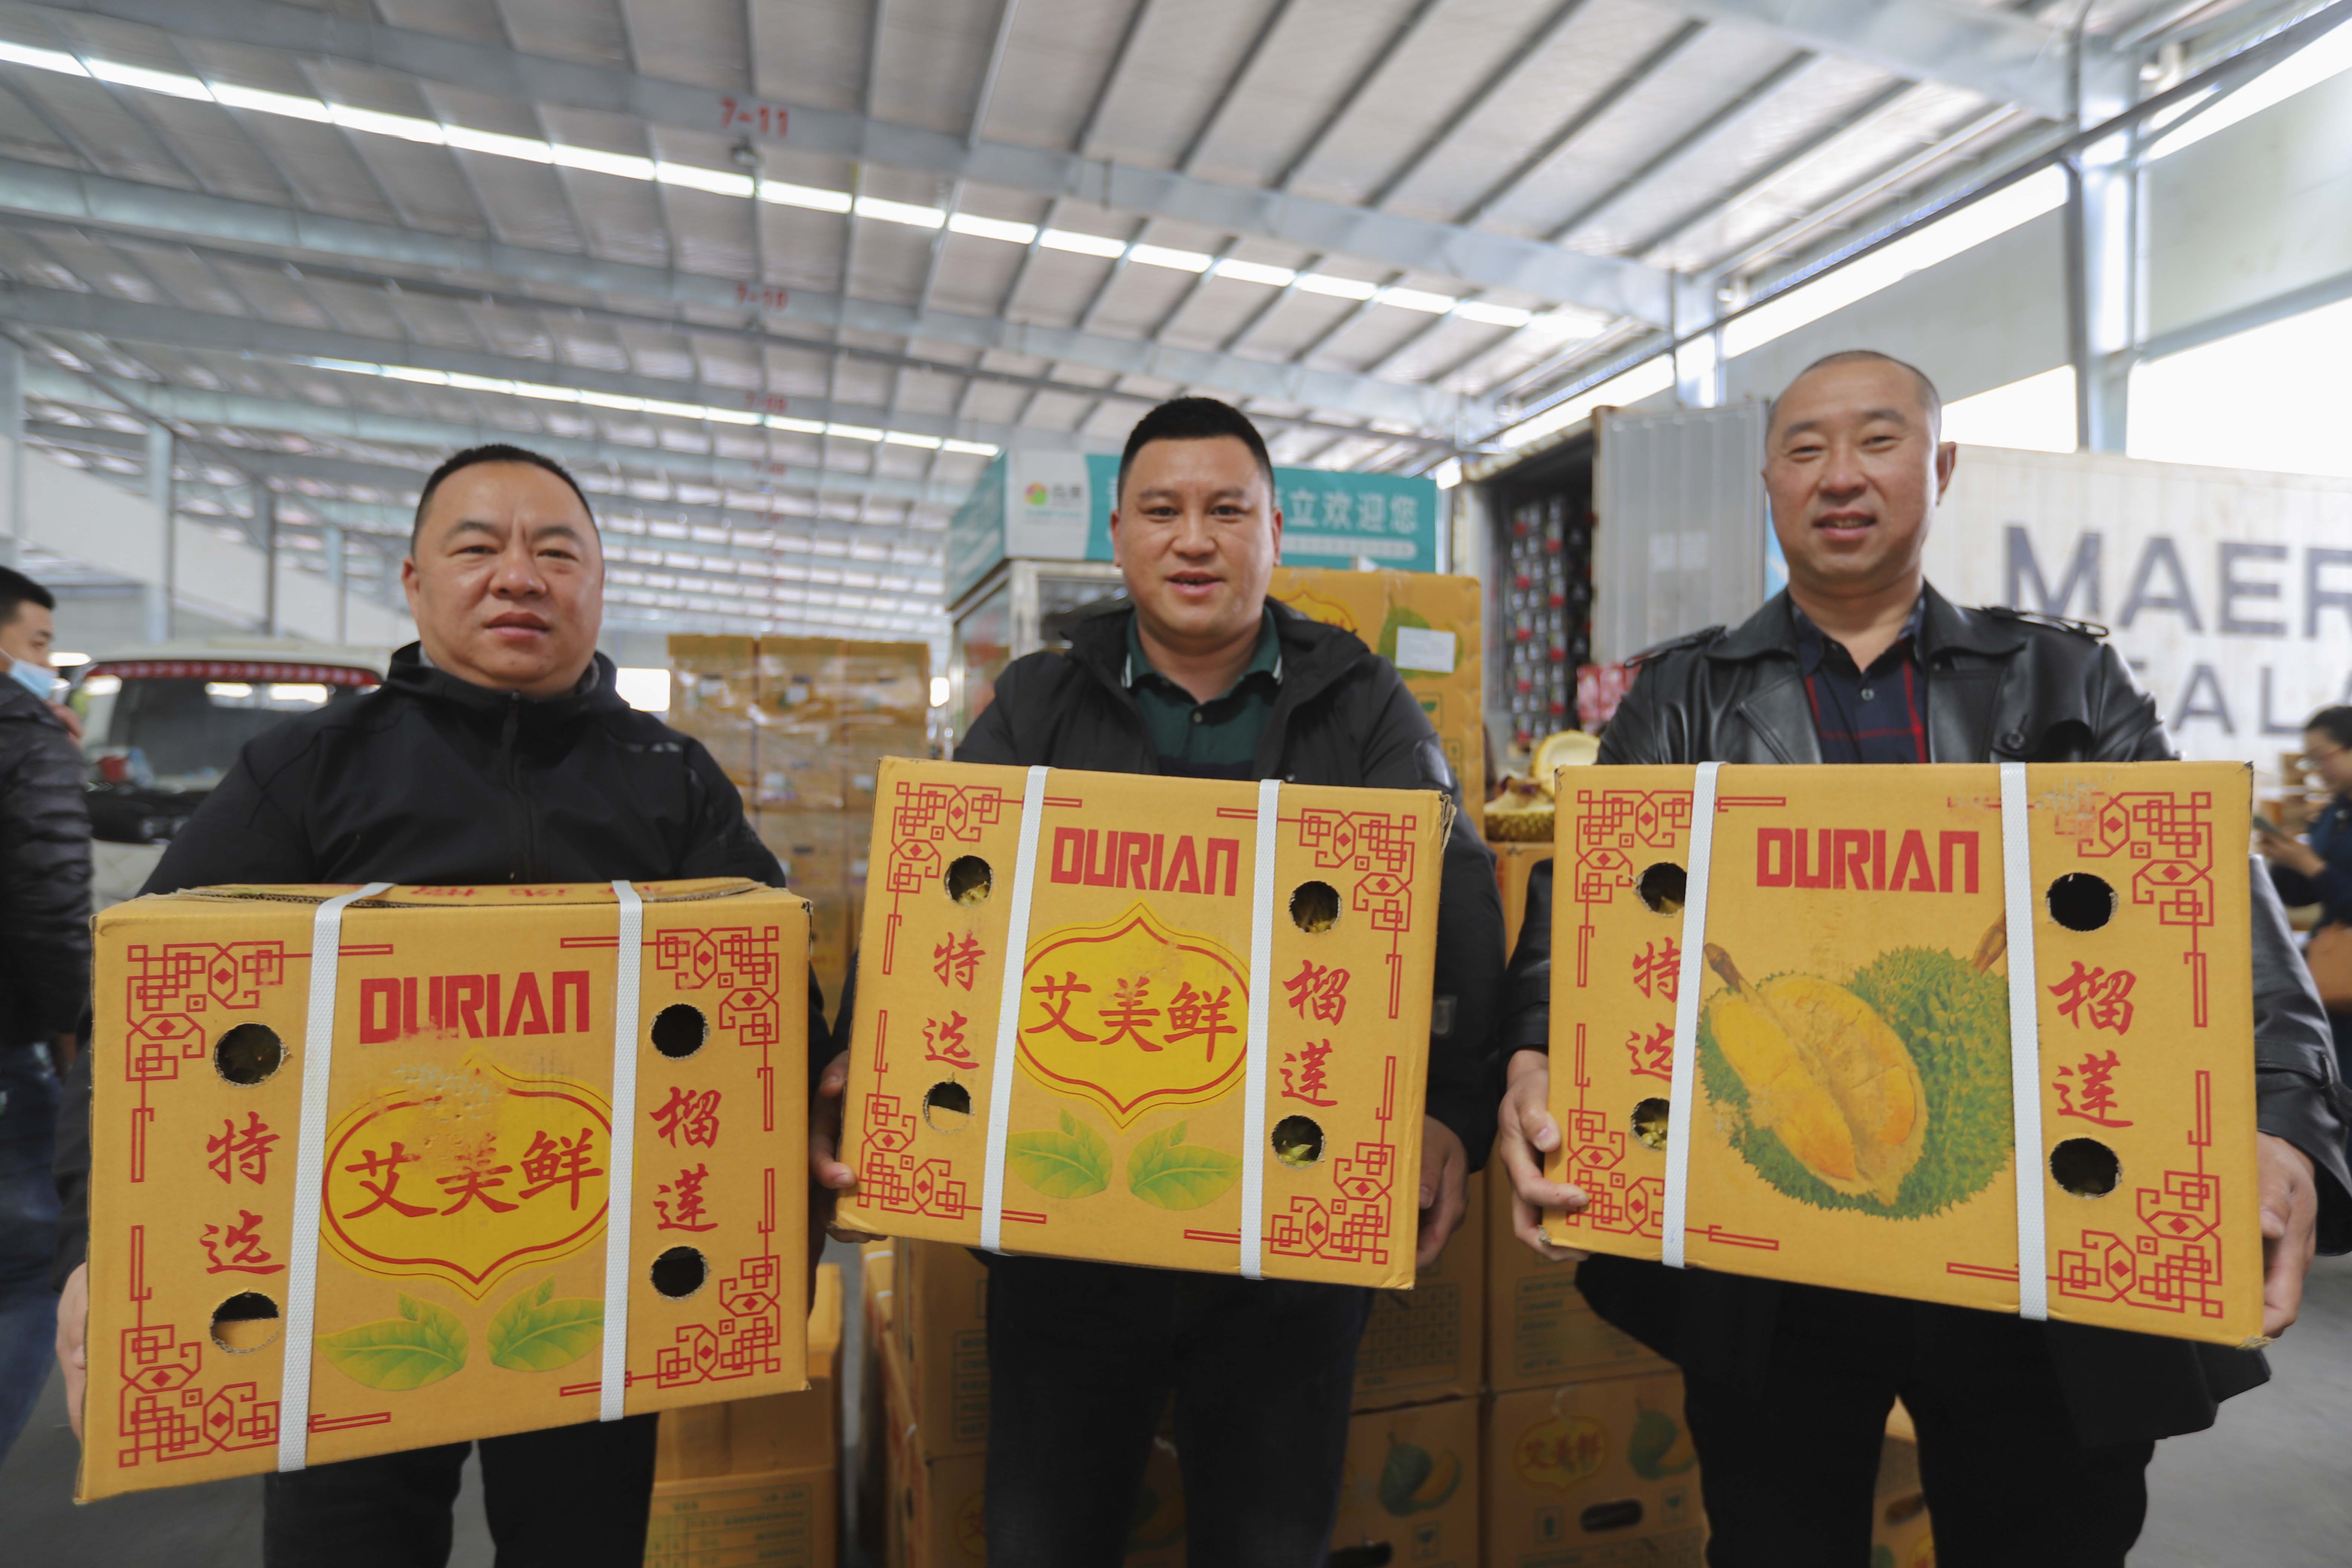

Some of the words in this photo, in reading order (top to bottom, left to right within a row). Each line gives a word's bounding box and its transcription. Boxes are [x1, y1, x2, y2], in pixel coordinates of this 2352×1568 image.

[718, 96, 789, 139] 7-11
[1275, 486, 1419, 534] 立欢迎您
[1050, 826, 1240, 897] DURIAN
[1756, 827, 1979, 894] DURIAN
[359, 970, 590, 1045] DURIAN
[922, 929, 986, 1070] 特选
[1024, 971, 1238, 1063] 艾美鲜
[199, 1110, 286, 1275] 特选
[342, 1127, 604, 1219] 艾美鲜
